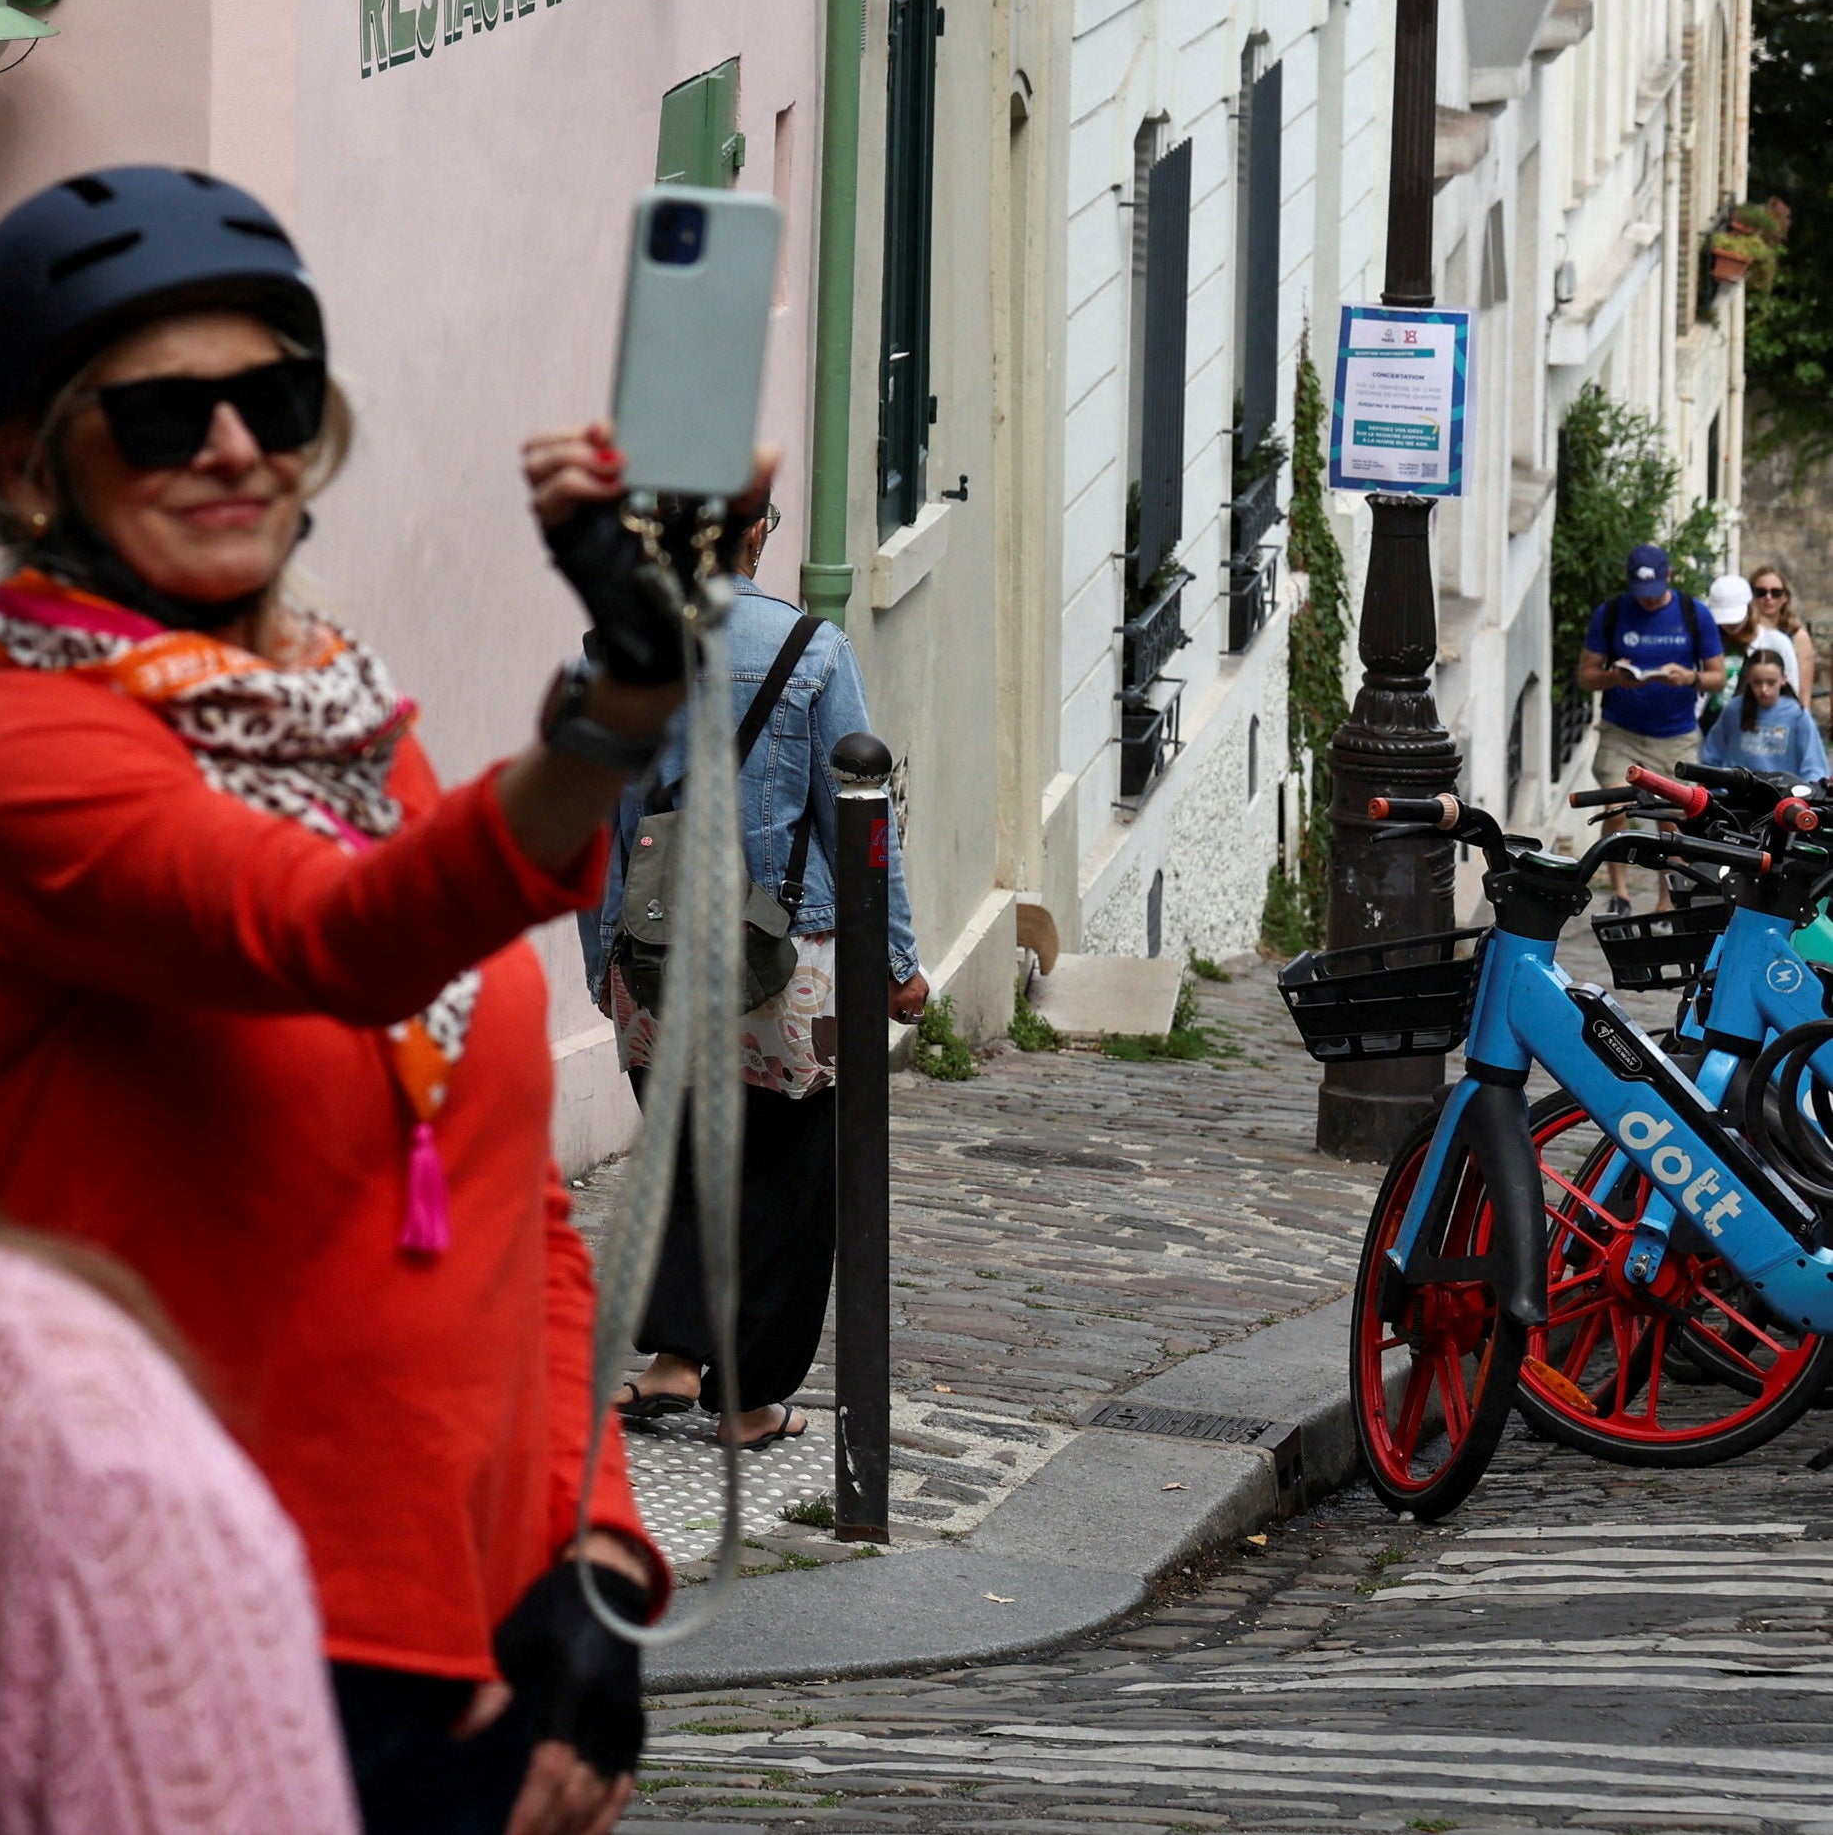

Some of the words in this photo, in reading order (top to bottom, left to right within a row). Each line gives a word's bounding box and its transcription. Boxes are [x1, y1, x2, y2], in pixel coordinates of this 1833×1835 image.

[1372, 372, 1425, 380] CONCERTATION
[1608, 1038, 1635, 1066] SEGWAY
[1619, 1111, 1742, 1238] dott
